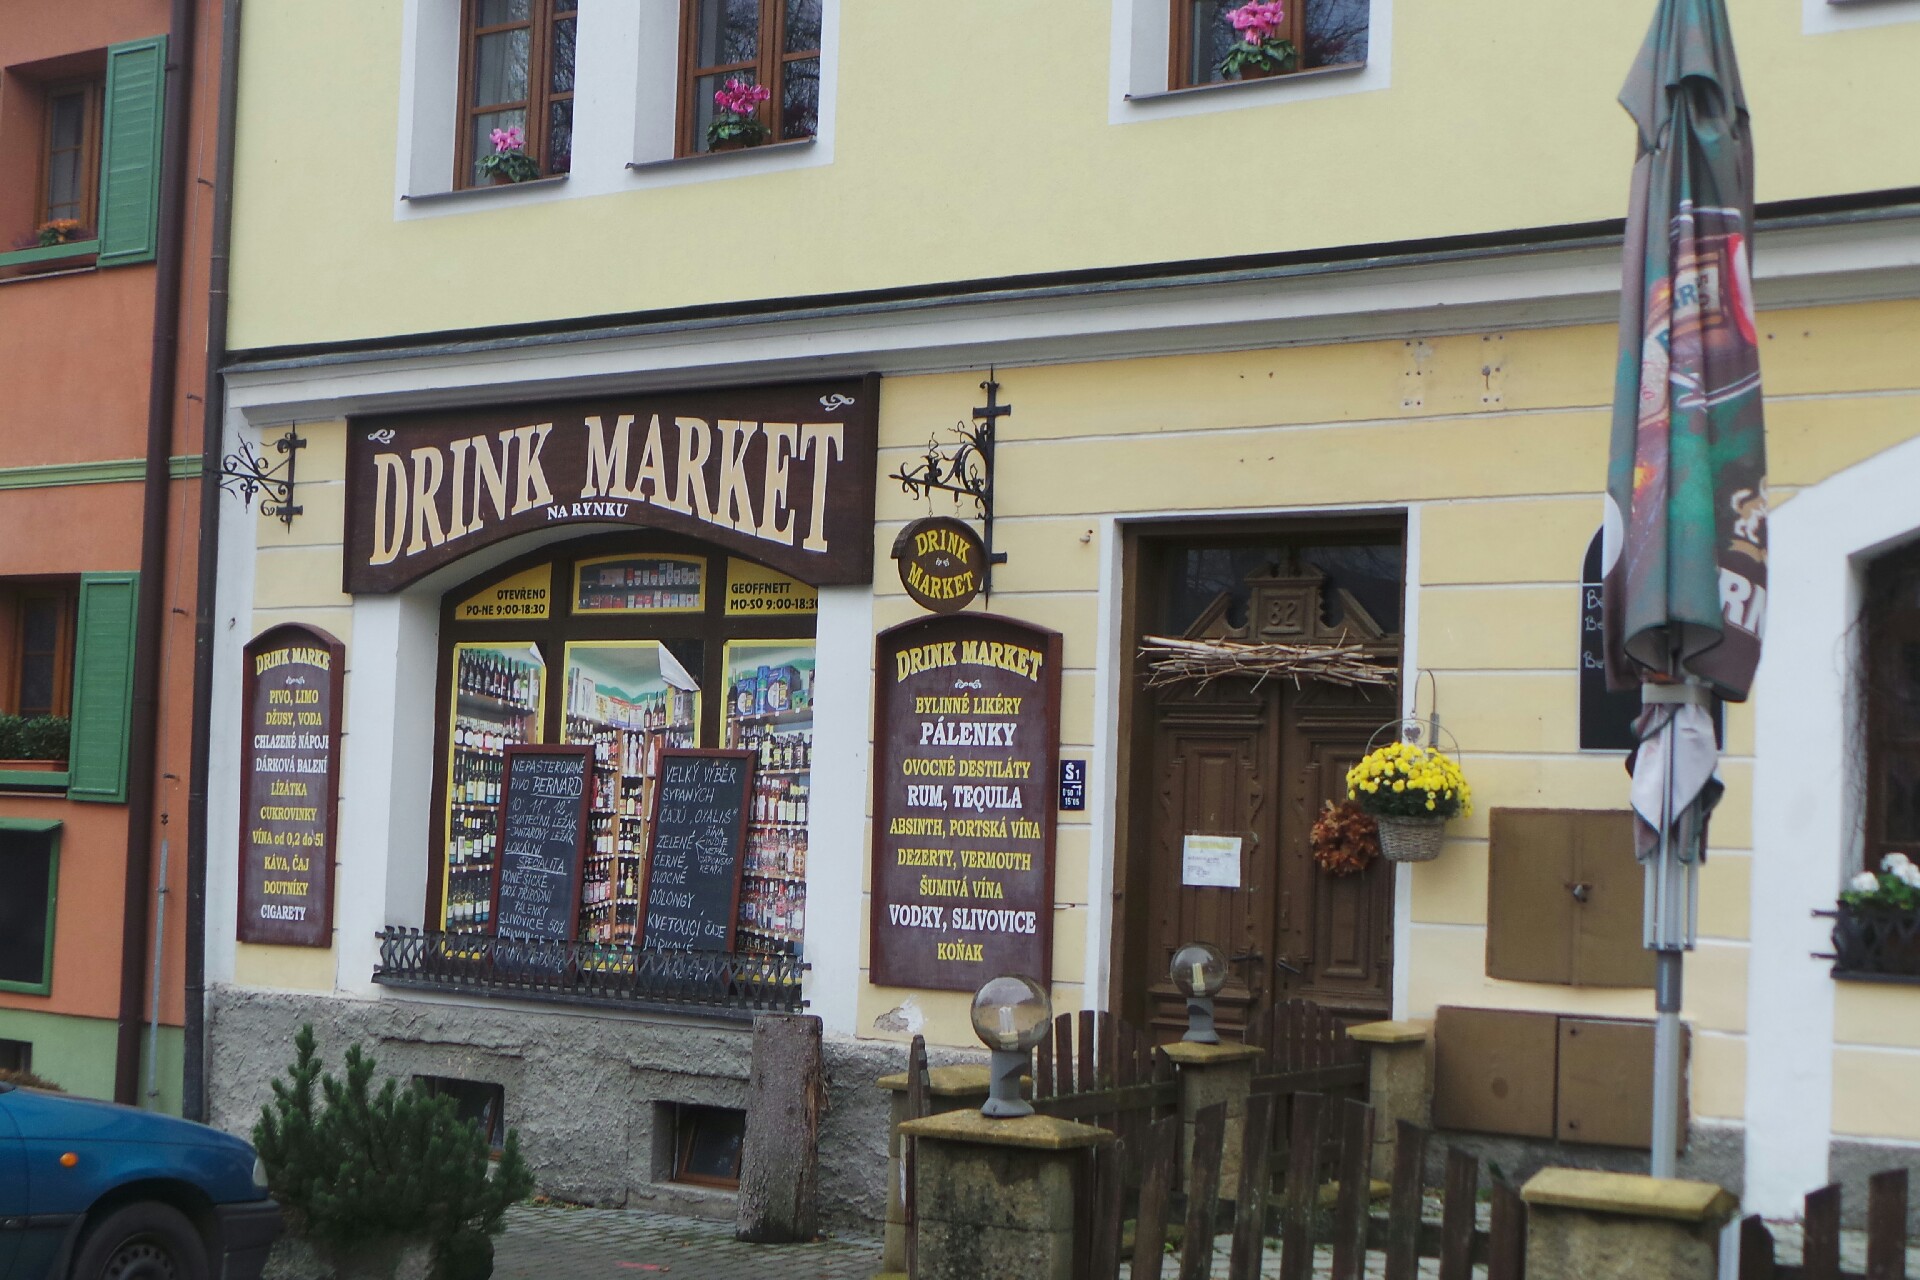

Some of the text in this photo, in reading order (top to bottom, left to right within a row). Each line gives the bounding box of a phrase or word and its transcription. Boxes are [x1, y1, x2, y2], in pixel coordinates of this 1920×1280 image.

[369, 413, 844, 567] DRINK MARKET
[546, 501, 629, 520] NA RYNKU
[914, 529, 970, 564] DRINK
[907, 561, 974, 599] MARKET
[496, 586, 546, 600] OTEVŘENO
[466, 604, 546, 616] PO-NE 9:00-18:30
[255, 648, 290, 676] DRINK
[895, 640, 1043, 683] DRINK MARKET
[269, 690, 319, 706] PIVO, LIMO
[915, 692, 1022, 715] BYLINNÉ LIKÉRY
[266, 709, 322, 728] DŽUSY, VODA
[254, 731, 297, 749] CHLAZENÉ
[919, 715, 1018, 746] PÁLENKY
[256, 754, 328, 774] DÁRKOVÁ BALENÍ
[666, 760, 700, 784] VELKÝ
[902, 755, 1031, 779] OVOCNÉ DESTILÁTY
[270, 778, 308, 796] LÍZÁTKA
[510, 776, 583, 796] PIVO BERNARD
[907, 785, 1023, 813] RUM, TEQUILA
[260, 806, 317, 821] CUKROVINKY
[252, 827, 273, 845] VÍNA
[274, 832, 285, 846] od
[286, 832, 301, 848] 0,2
[302, 833, 313, 847] do
[889, 816, 1041, 839] ABSINTH, PORTSKÁ VÍNA
[264, 853, 310, 873] KÁVA, ČAJ
[897, 848, 1032, 871] DEZERTY, VERMOUTH
[263, 878, 309, 896] DOUTNÍKY
[919, 874, 1004, 899] ŠUMIVÁ VÍNA
[260, 904, 307, 921] CIGARETY
[498, 912, 544, 930] SLIVOVICE
[889, 904, 1036, 934] VODKY, SLIVOVICE
[937, 938, 984, 961] KOŇAK
